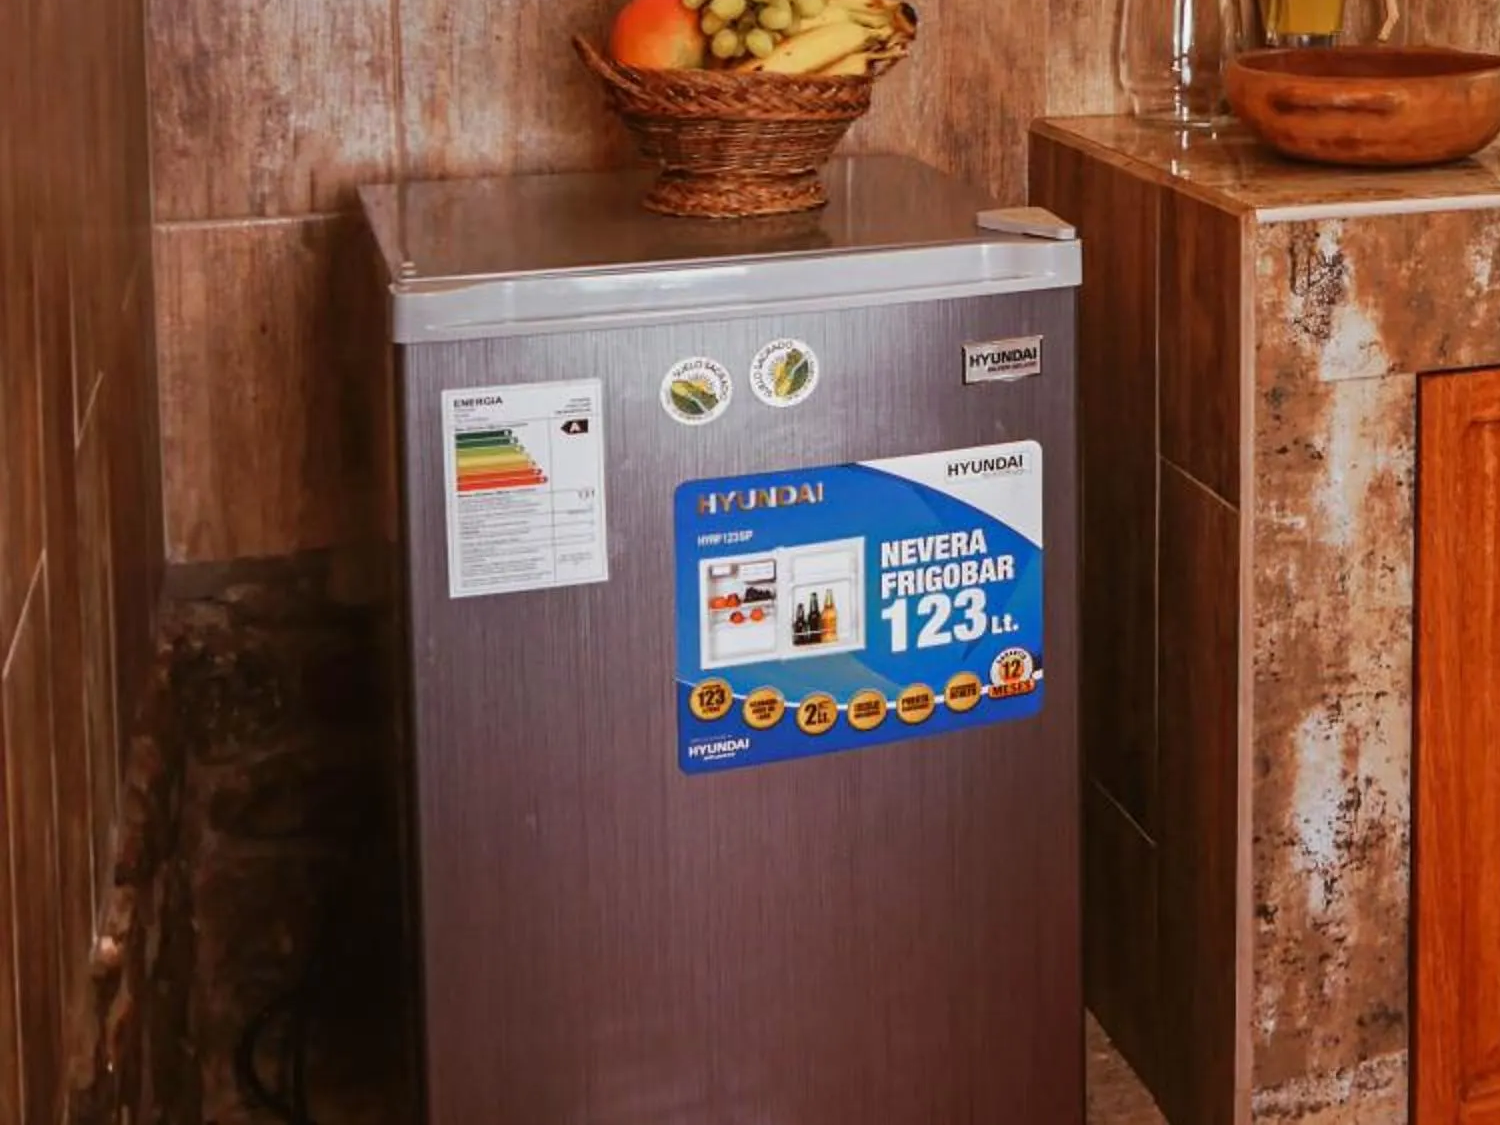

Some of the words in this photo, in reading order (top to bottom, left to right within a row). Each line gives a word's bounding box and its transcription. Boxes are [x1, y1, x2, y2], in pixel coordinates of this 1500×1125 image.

[969, 347, 1037, 368] HYUNDAI
[453, 395, 503, 408] ENERGIA
[947, 454, 1024, 476] HYUNDAI
[697, 482, 824, 516] HYUNDAI
[881, 528, 988, 569] NEVERA
[881, 554, 1015, 600] FRIGOBAR
[881, 588, 988, 653] 123
[1002, 659, 1021, 679] 12
[698, 687, 726, 708] 123
[804, 703, 817, 726] 2
[688, 738, 749, 759] HYUNDAI
